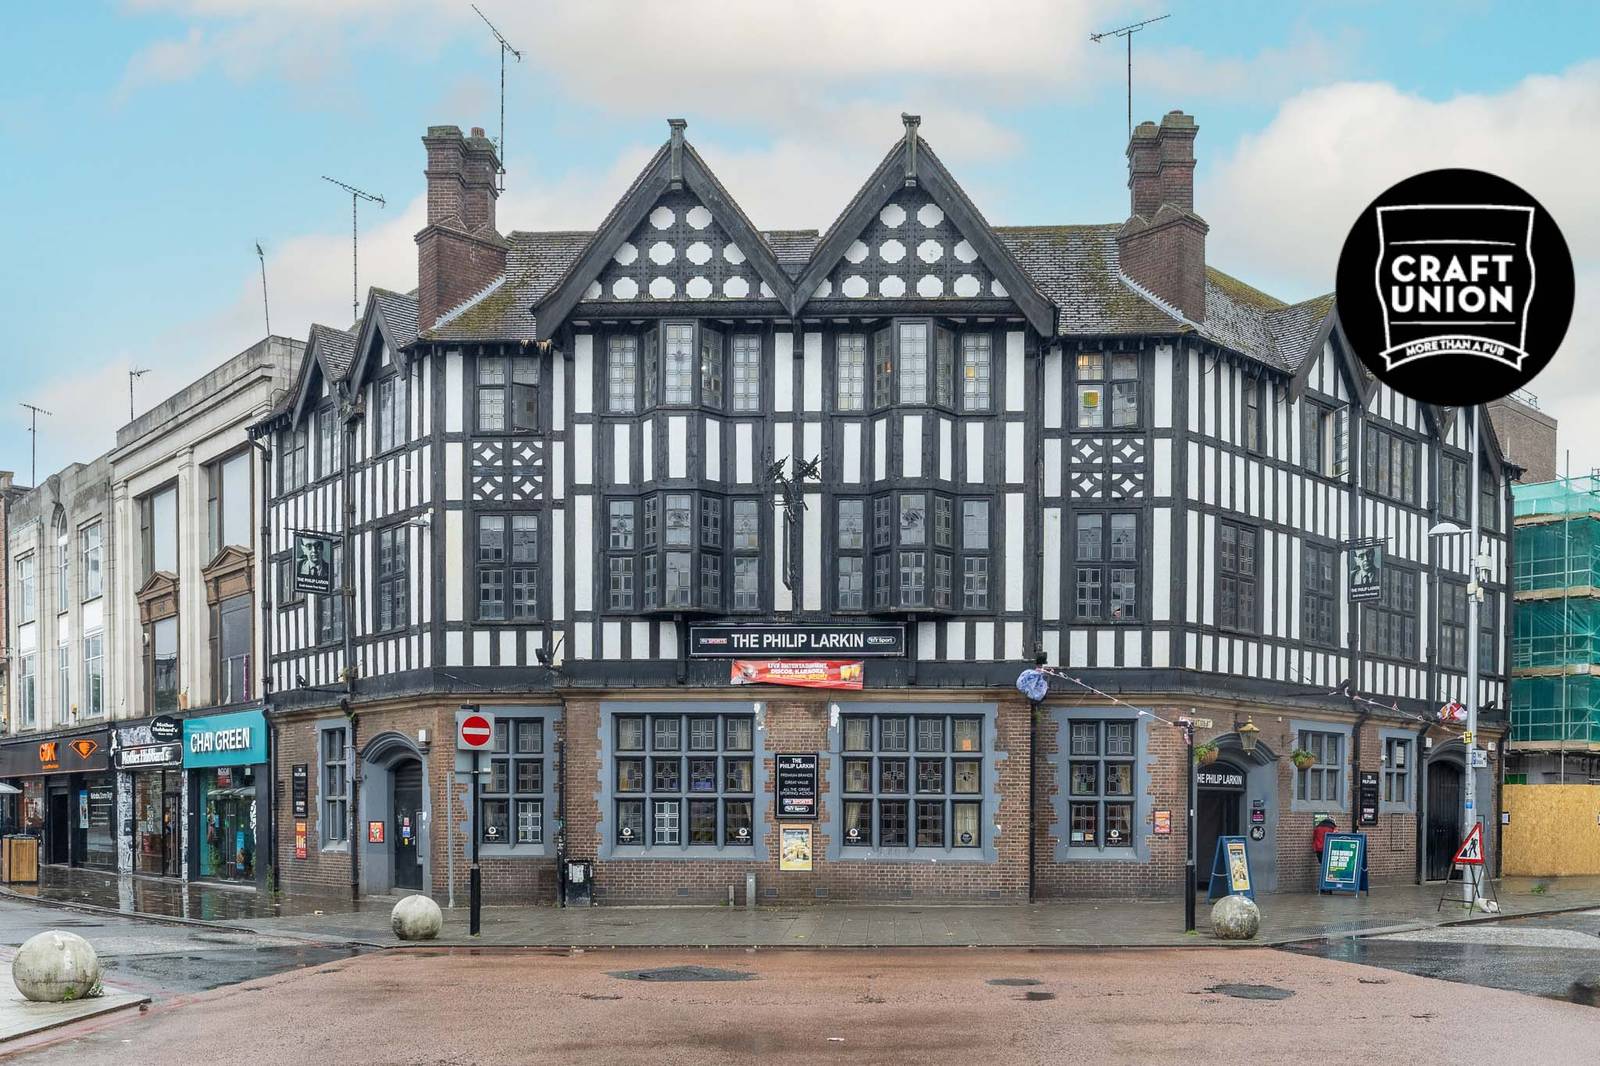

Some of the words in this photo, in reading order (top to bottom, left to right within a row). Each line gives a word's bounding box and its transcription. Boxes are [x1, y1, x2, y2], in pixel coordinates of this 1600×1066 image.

[731, 634, 759, 648] THE
[763, 634, 807, 648] PHILIP
[811, 634, 864, 648] LARKIN
[191, 731, 213, 752] CHAI
[215, 727, 250, 750] GREEN
[1197, 774, 1205, 783] HE
[1206, 774, 1222, 784] PHILIP
[1223, 775, 1242, 784] LARKIN
